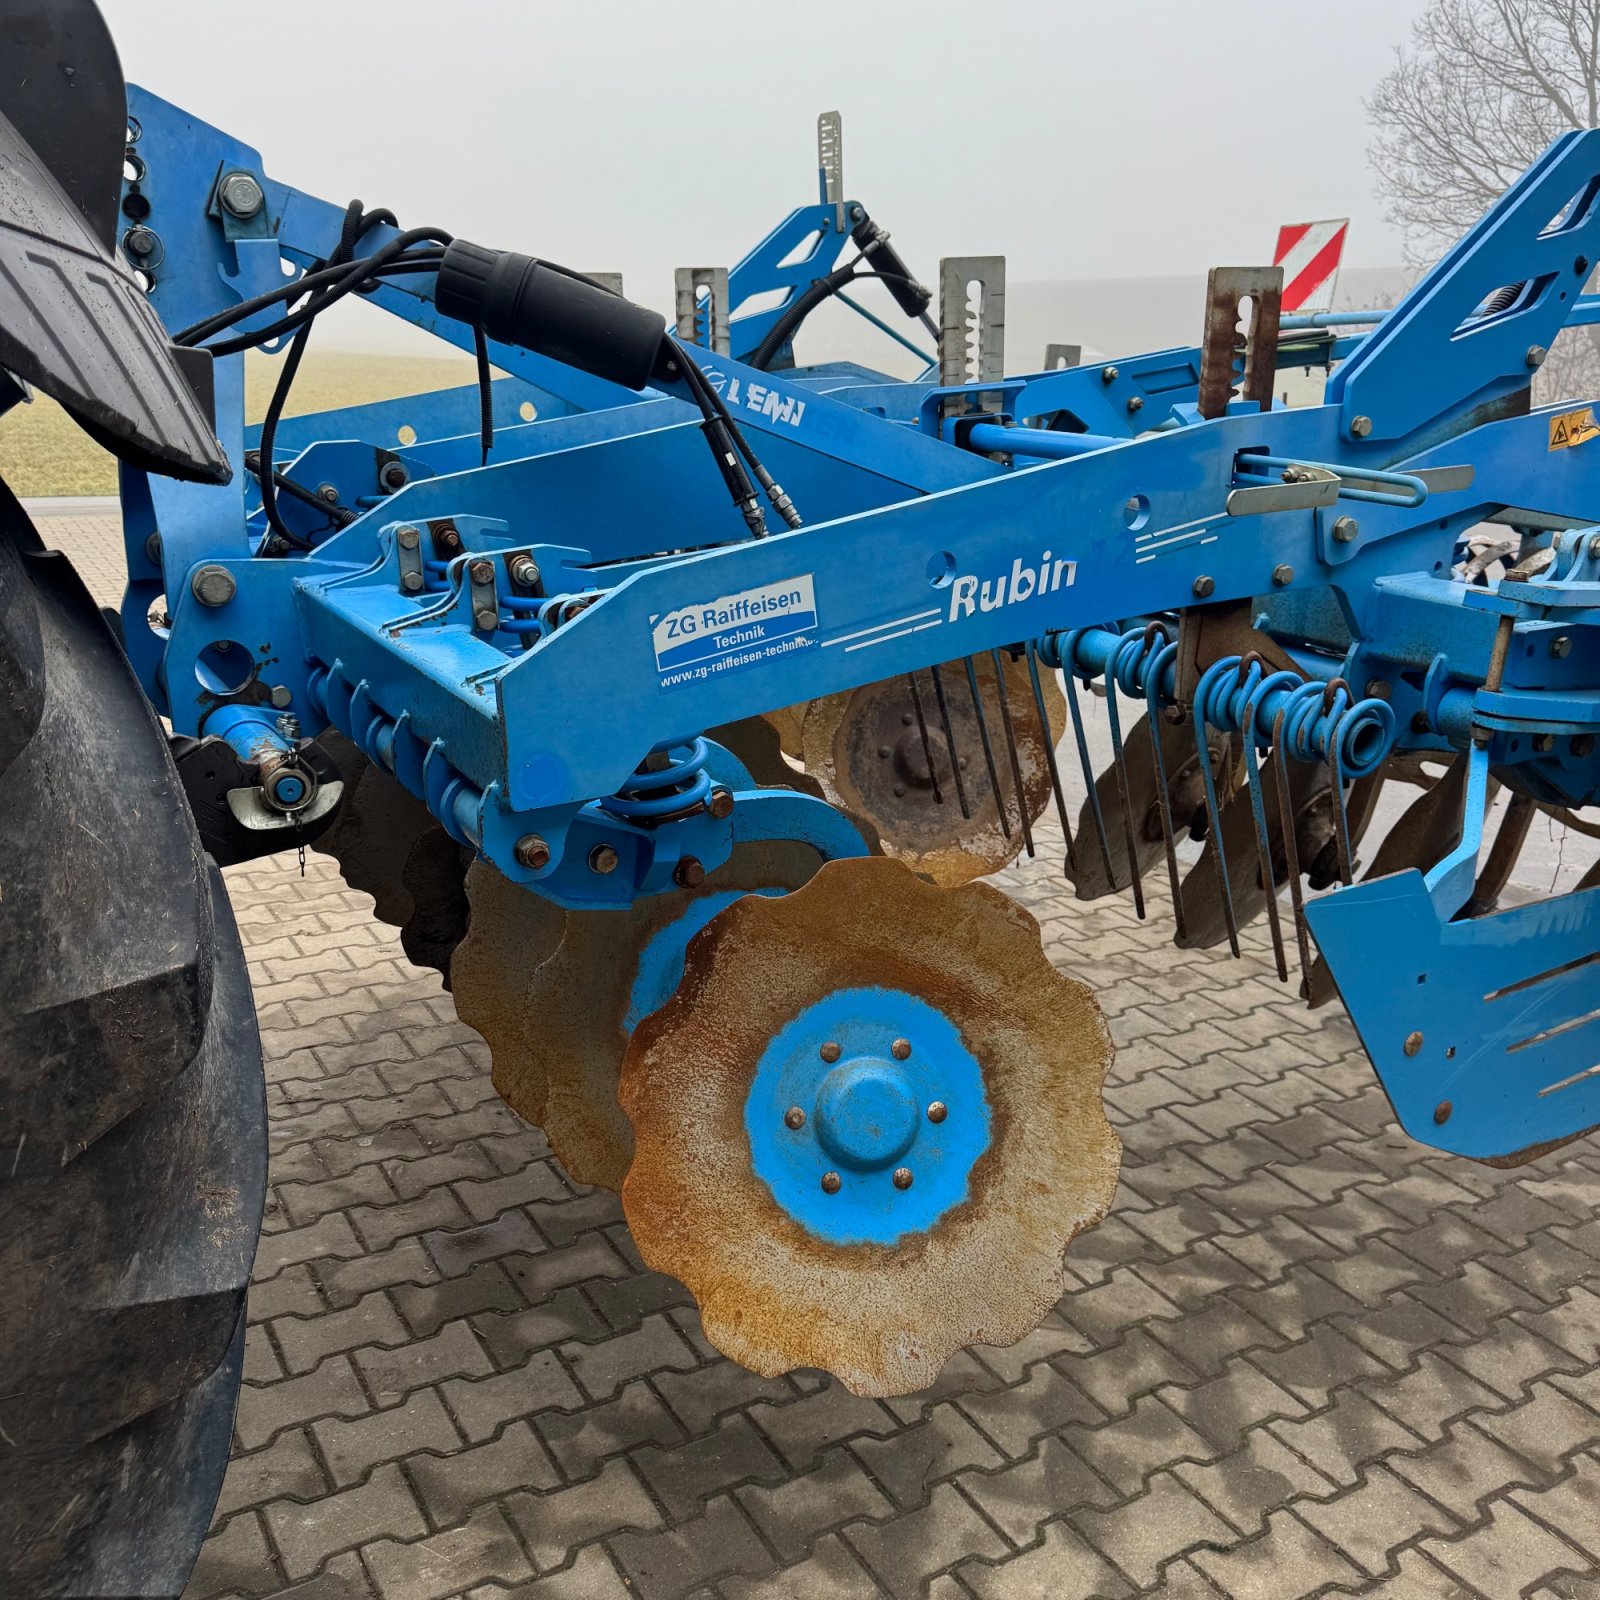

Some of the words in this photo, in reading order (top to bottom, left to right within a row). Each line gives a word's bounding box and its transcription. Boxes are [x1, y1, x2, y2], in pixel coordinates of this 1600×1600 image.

[948, 549, 1078, 623] Rubin
[665, 615, 697, 639] ZG
[702, 590, 802, 629] Raiffeisen
[713, 625, 765, 649] Technik
